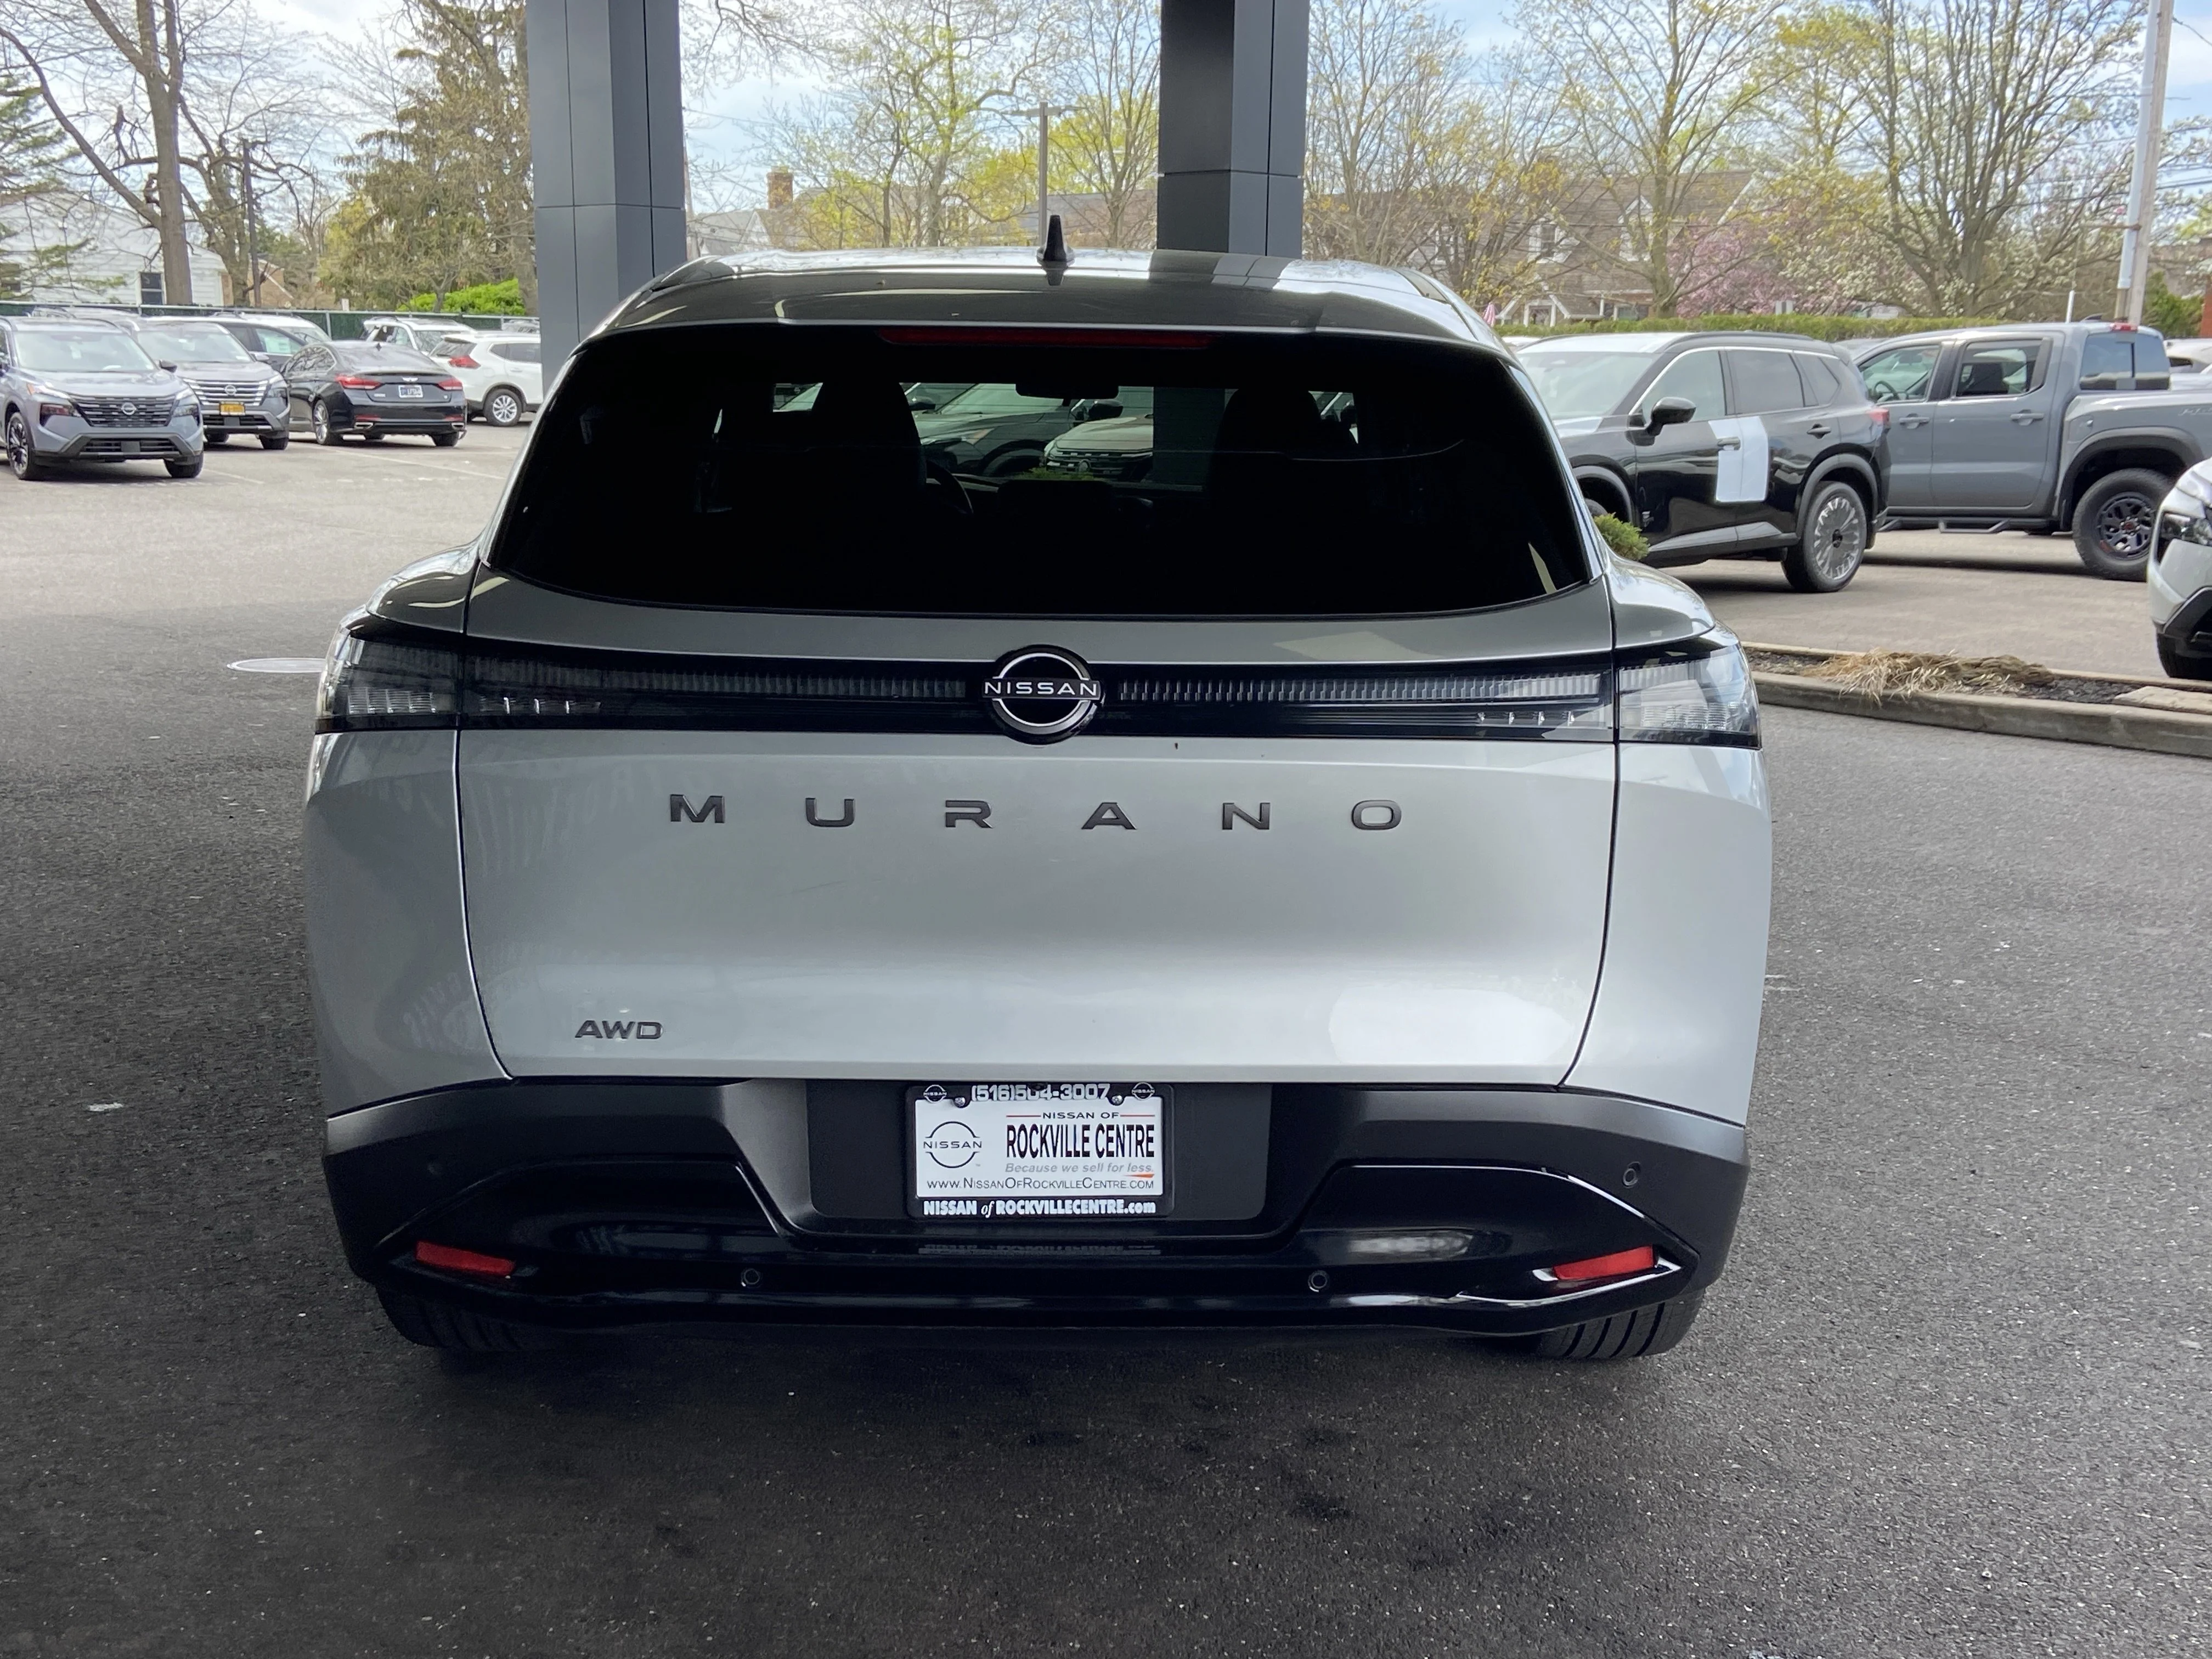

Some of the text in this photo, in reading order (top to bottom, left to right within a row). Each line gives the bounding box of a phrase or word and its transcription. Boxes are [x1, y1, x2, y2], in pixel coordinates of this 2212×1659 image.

[984, 681, 1097, 696] NISSAN
[670, 794, 1402, 831] MURANO
[574, 1020, 663, 1040] AWD
[923, 1141, 983, 1149] NISSAN
[1006, 1122, 1155, 1159] ROCKVILLE CENTRE
[1005, 1163, 1058, 1173] Because
[1062, 1165, 1079, 1173] we
[1082, 1163, 1104, 1172] sell
[1107, 1163, 1124, 1172] for
[923, 1199, 1156, 1218] NISSAN of ROCKVILLECENTRE.com
